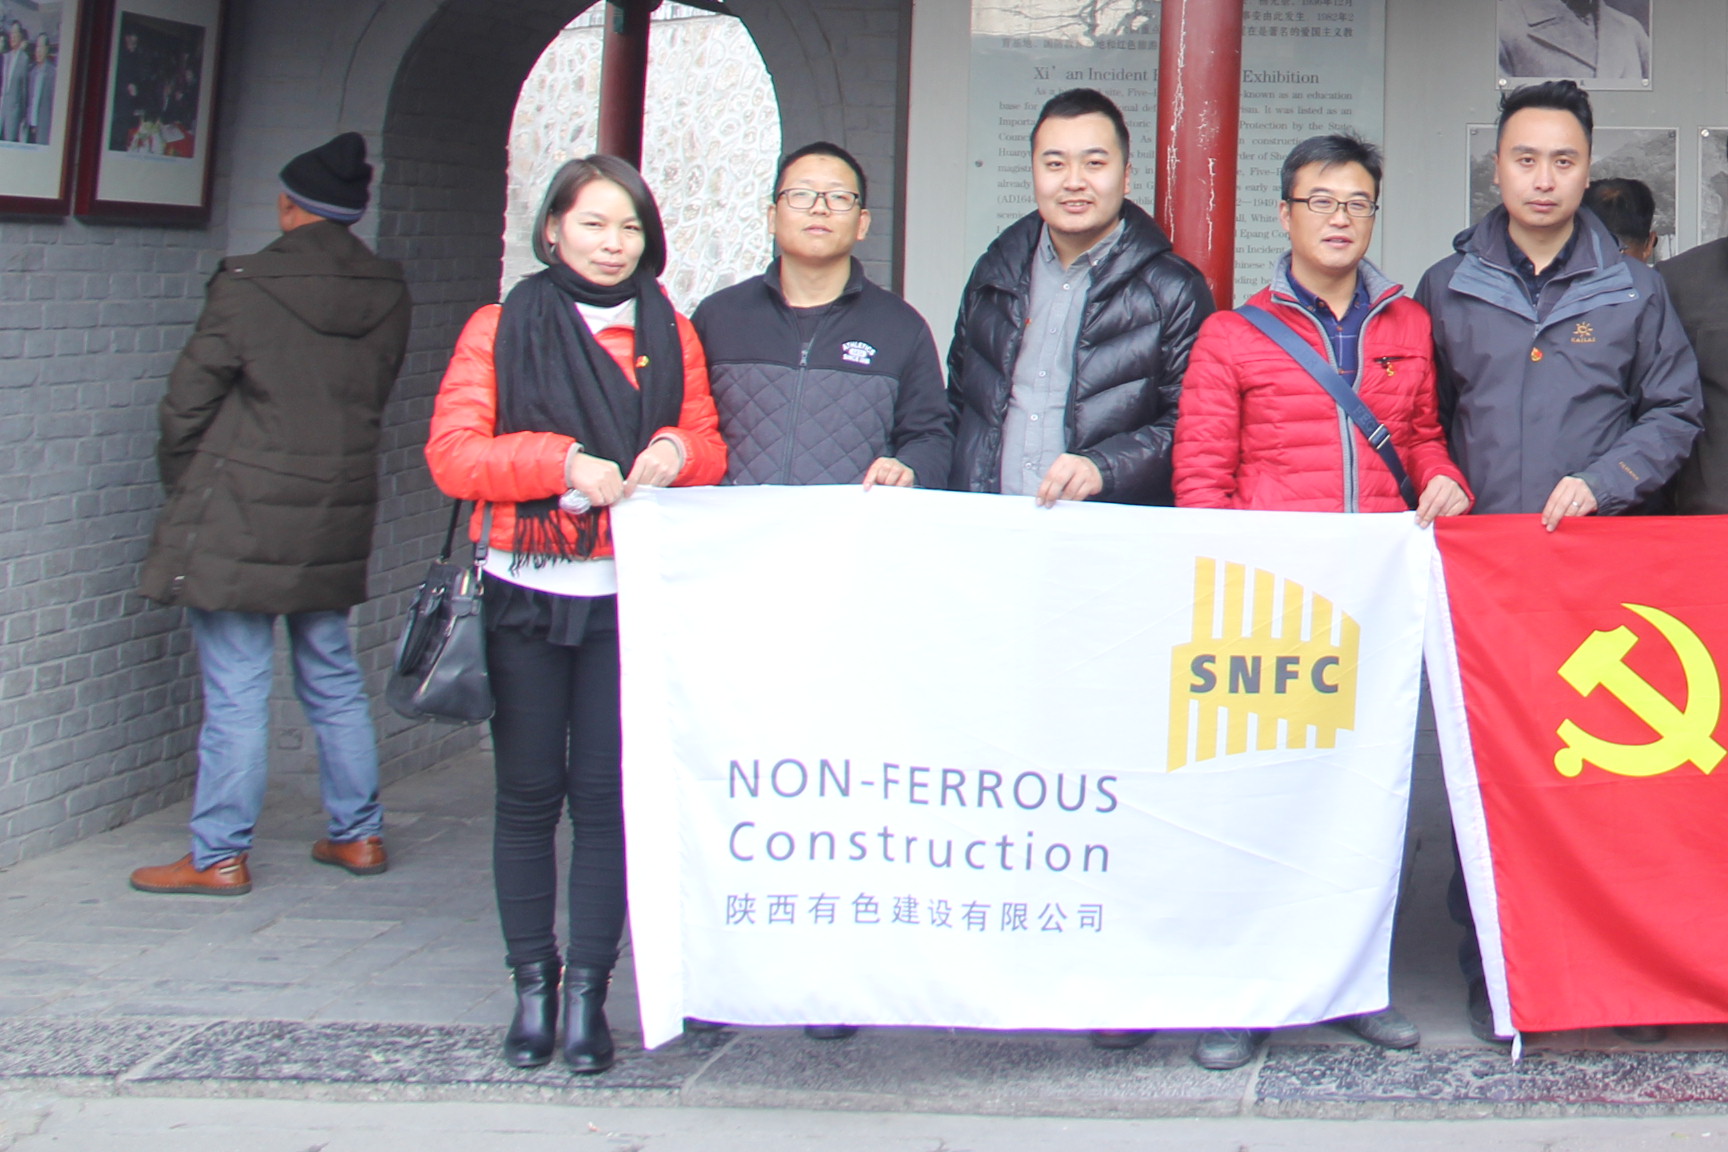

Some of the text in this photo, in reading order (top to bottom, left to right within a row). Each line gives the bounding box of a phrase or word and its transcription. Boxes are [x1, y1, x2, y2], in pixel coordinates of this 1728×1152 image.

[1088, 67, 1148, 81] Incident
[1242, 69, 1320, 84] Exhibition
[1306, 91, 1353, 100] education
[999, 117, 1036, 127] Importa
[1189, 654, 1341, 695] SNFC
[728, 759, 1119, 814] NON-FERROUS
[728, 821, 1111, 873] Construction
[726, 892, 1106, 934] 陕西有色建设有限公司
